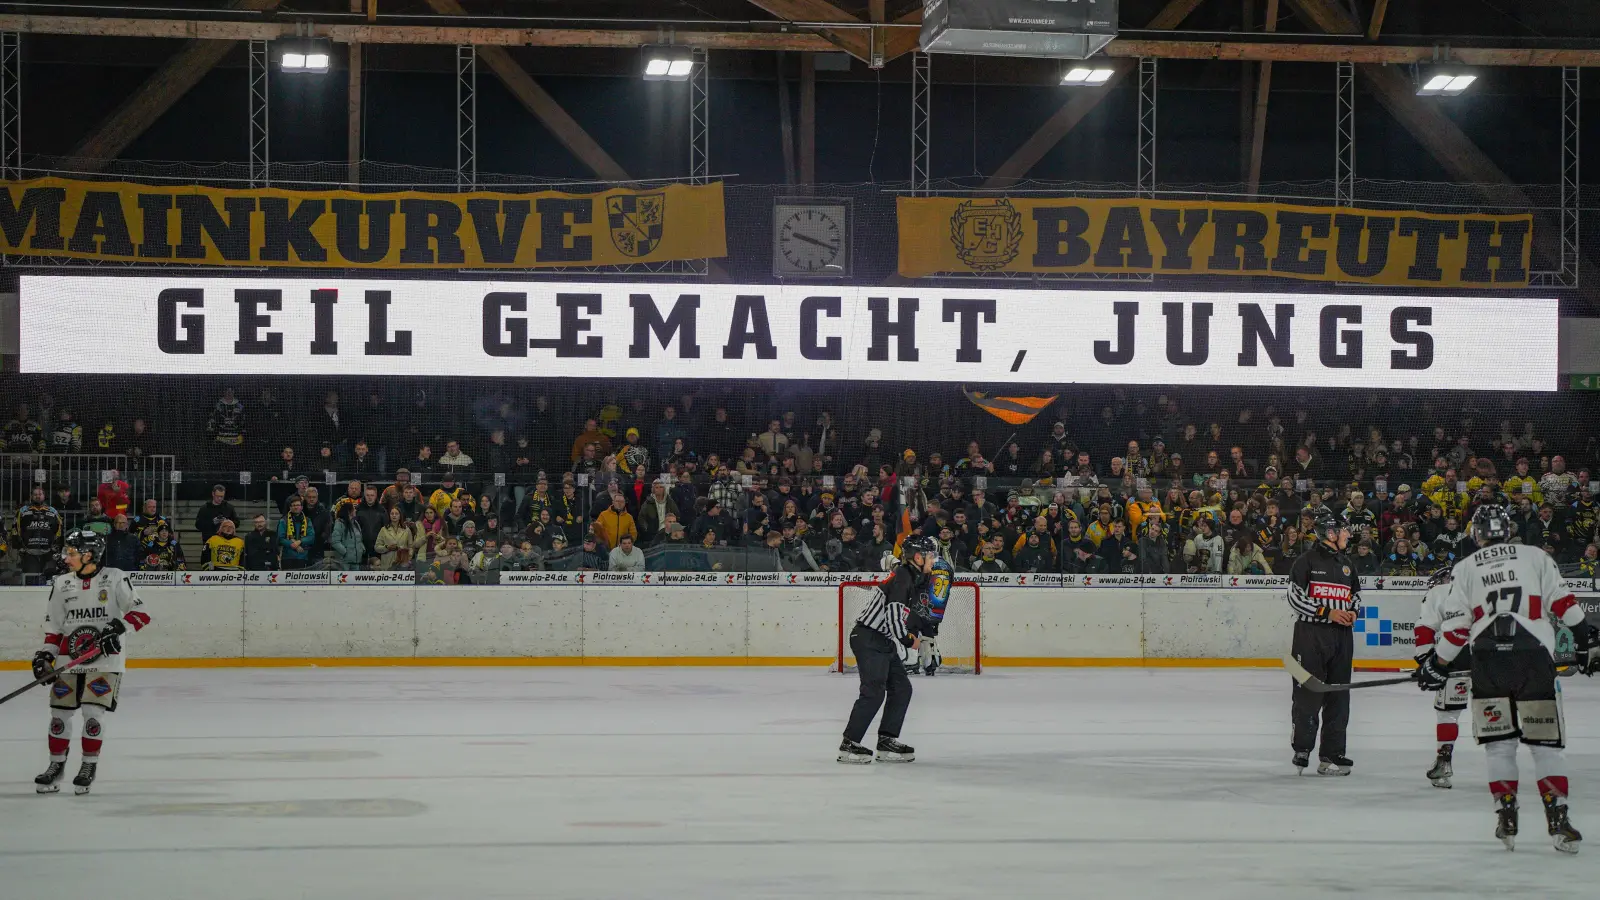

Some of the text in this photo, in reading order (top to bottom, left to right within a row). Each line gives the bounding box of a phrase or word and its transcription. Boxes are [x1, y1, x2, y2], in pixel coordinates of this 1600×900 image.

[0, 187, 593, 263] MAINKURVE
[1032, 206, 1527, 284] BAYREUTH
[157, 288, 1435, 372] GEIL GEMACHT, JUNGS
[1474, 545, 1517, 561] HESKO
[129, 572, 174, 581] Piotrowski
[198, 574, 260, 583] www.pio-24.de
[285, 572, 329, 581] Piotrowski
[354, 574, 415, 583] www.pio-24.de
[508, 574, 568, 582] www.pio-24.de
[592, 573, 635, 581] Piotrowski
[1098, 576, 1157, 585] www.pio-24.de
[1482, 570, 1518, 587] MAUL D.
[1313, 586, 1350, 598] PENNY
[76, 607, 109, 619] HAIDL
